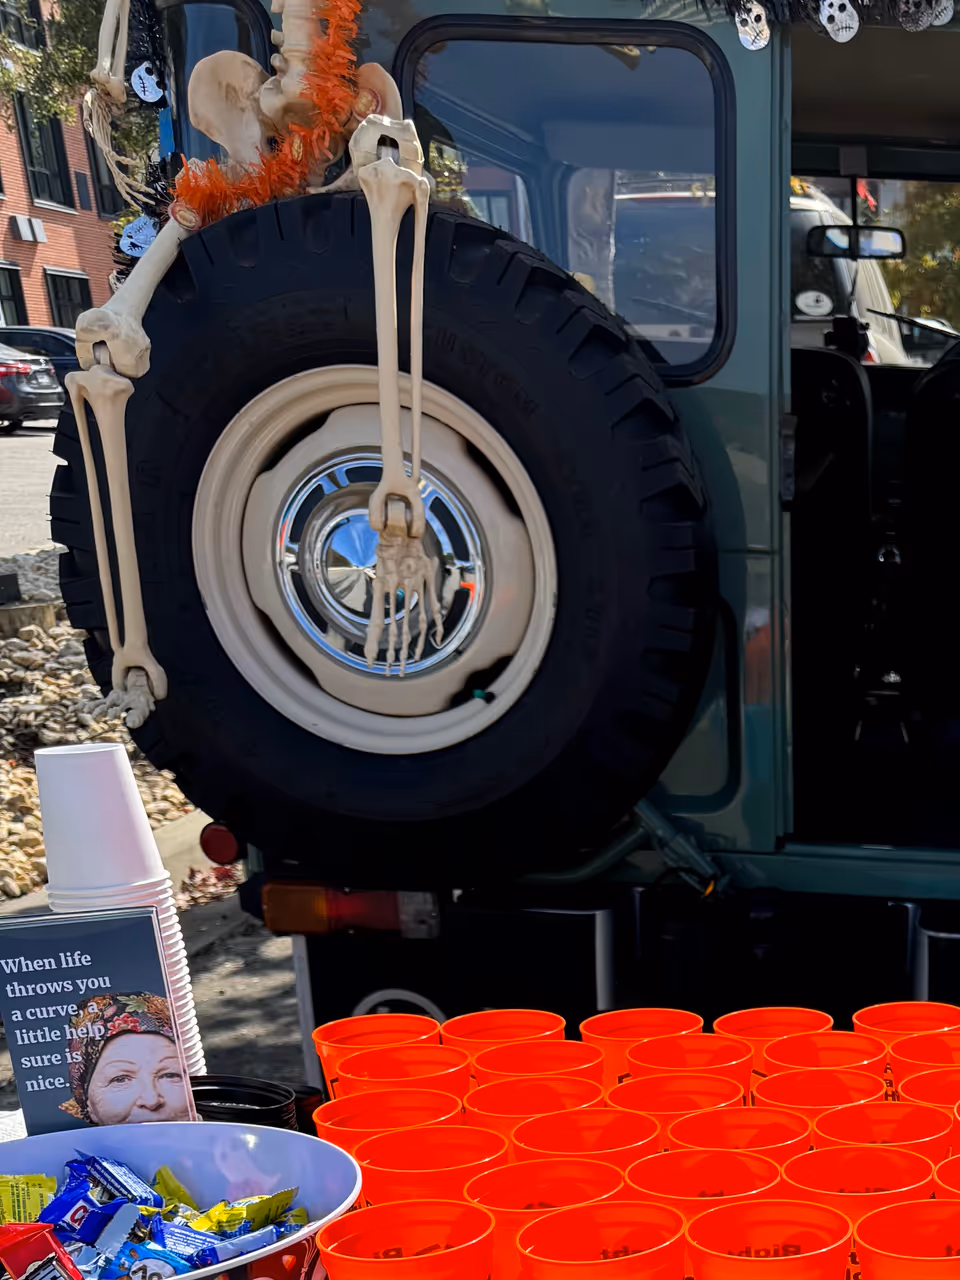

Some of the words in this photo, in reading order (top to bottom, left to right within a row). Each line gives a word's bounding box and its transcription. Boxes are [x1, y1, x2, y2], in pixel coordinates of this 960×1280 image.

[0, 957, 57, 974] When
[59, 951, 92, 968] life
[6, 981, 73, 998] throws
[76, 976, 111, 994] you
[11, 1009, 23, 1021] a
[26, 1003, 84, 1020] curve,
[87, 1001, 98, 1013] a
[15, 1026, 61, 1045] little
[64, 1022, 105, 1040] help
[21, 1053, 62, 1068] sure
[65, 1048, 82, 1063] is
[26, 1075, 70, 1092] nice.
